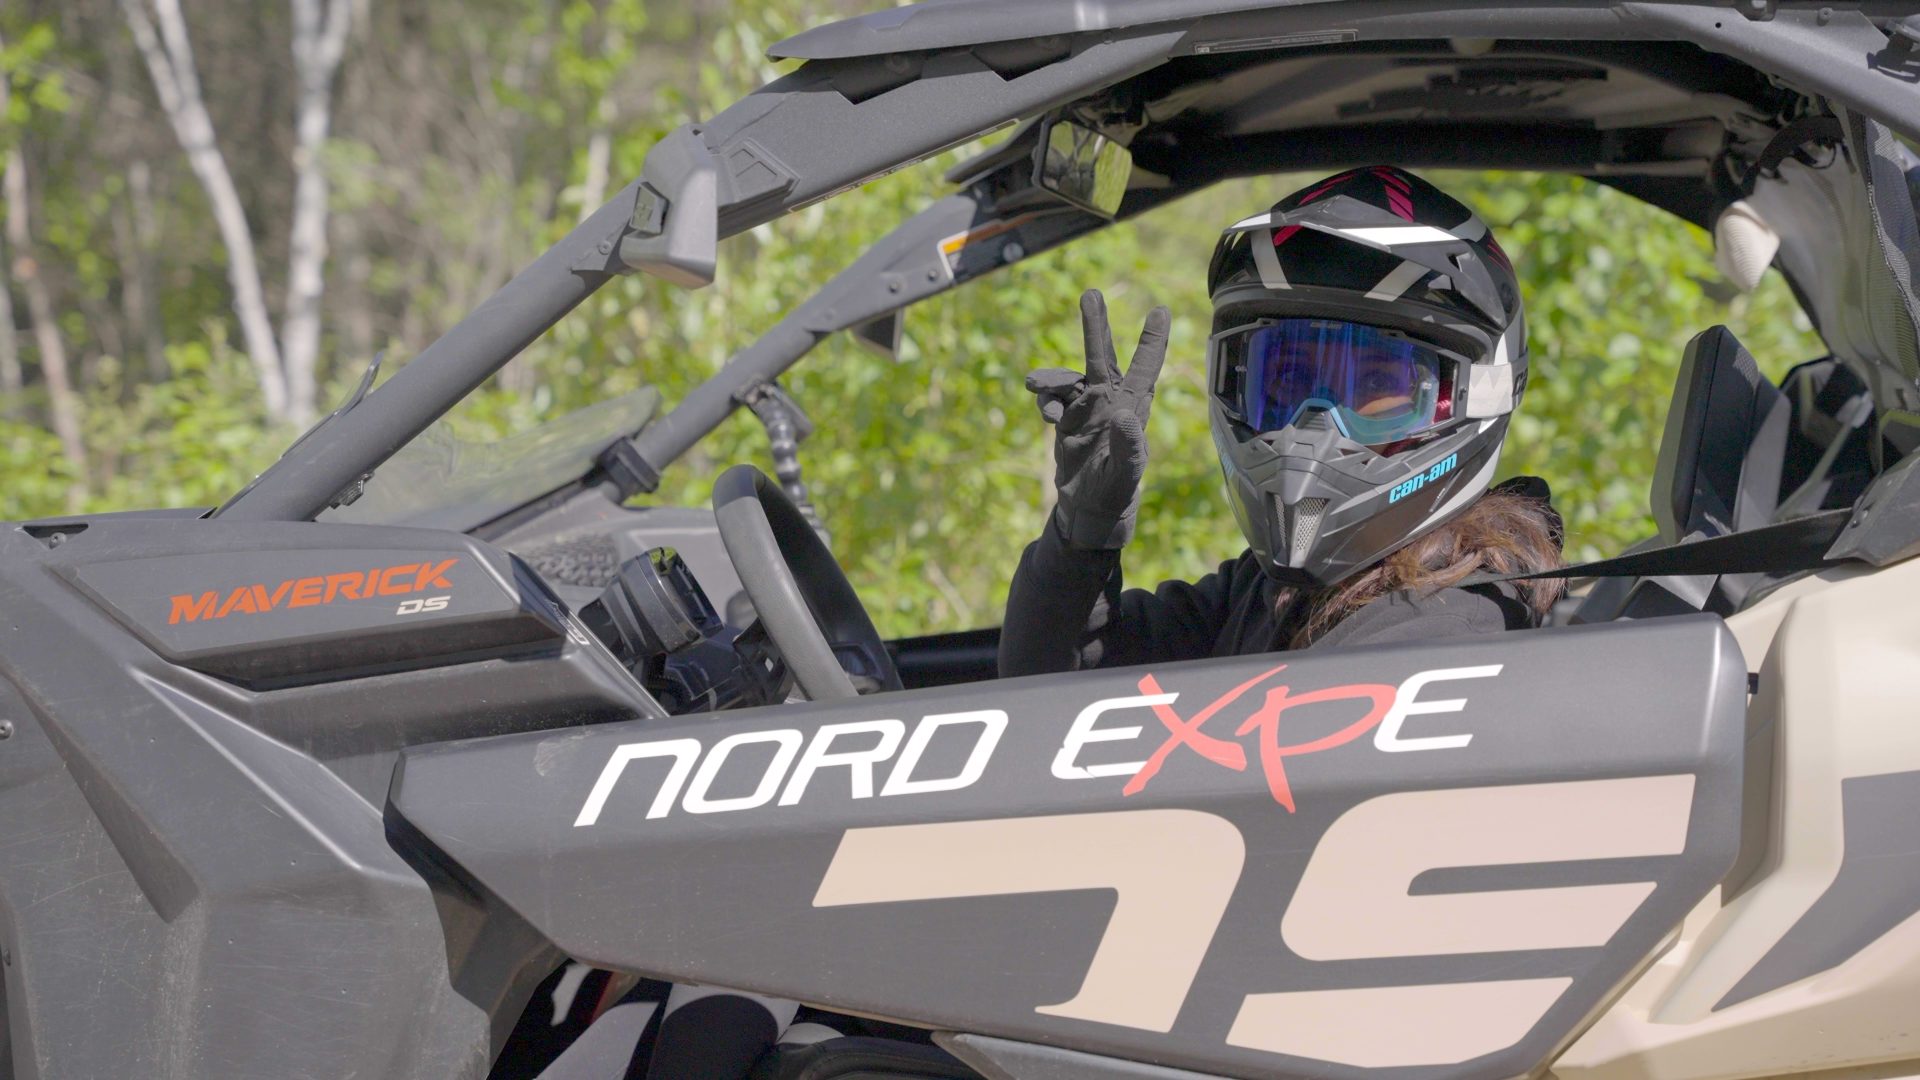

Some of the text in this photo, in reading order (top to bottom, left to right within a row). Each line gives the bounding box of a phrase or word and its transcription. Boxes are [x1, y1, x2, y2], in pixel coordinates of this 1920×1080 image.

[168, 558, 460, 625] MAVERICK
[396, 595, 451, 616] DS
[574, 709, 1008, 827] NORD
